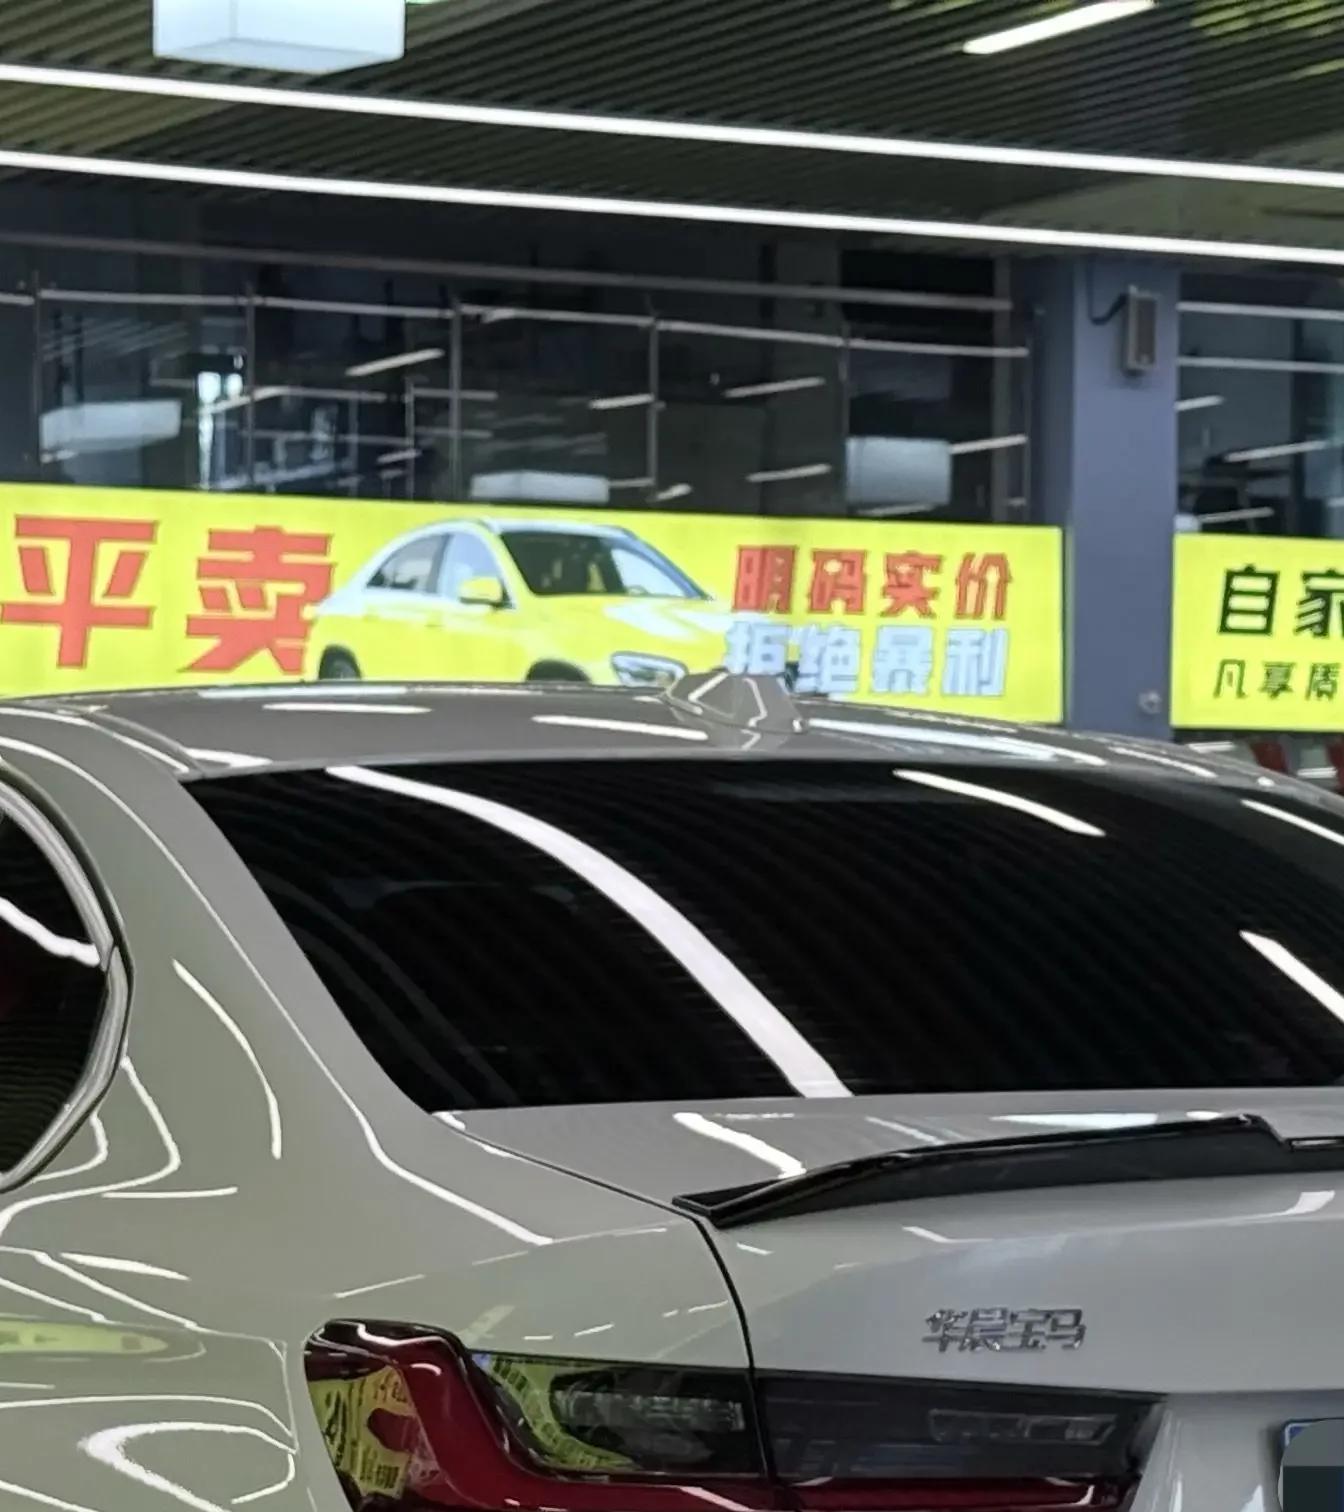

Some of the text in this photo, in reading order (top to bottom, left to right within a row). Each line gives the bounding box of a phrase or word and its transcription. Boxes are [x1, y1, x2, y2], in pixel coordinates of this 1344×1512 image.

[730, 543, 1014, 621] 明码实价
[723, 621, 1010, 699] 拒绝暴利
